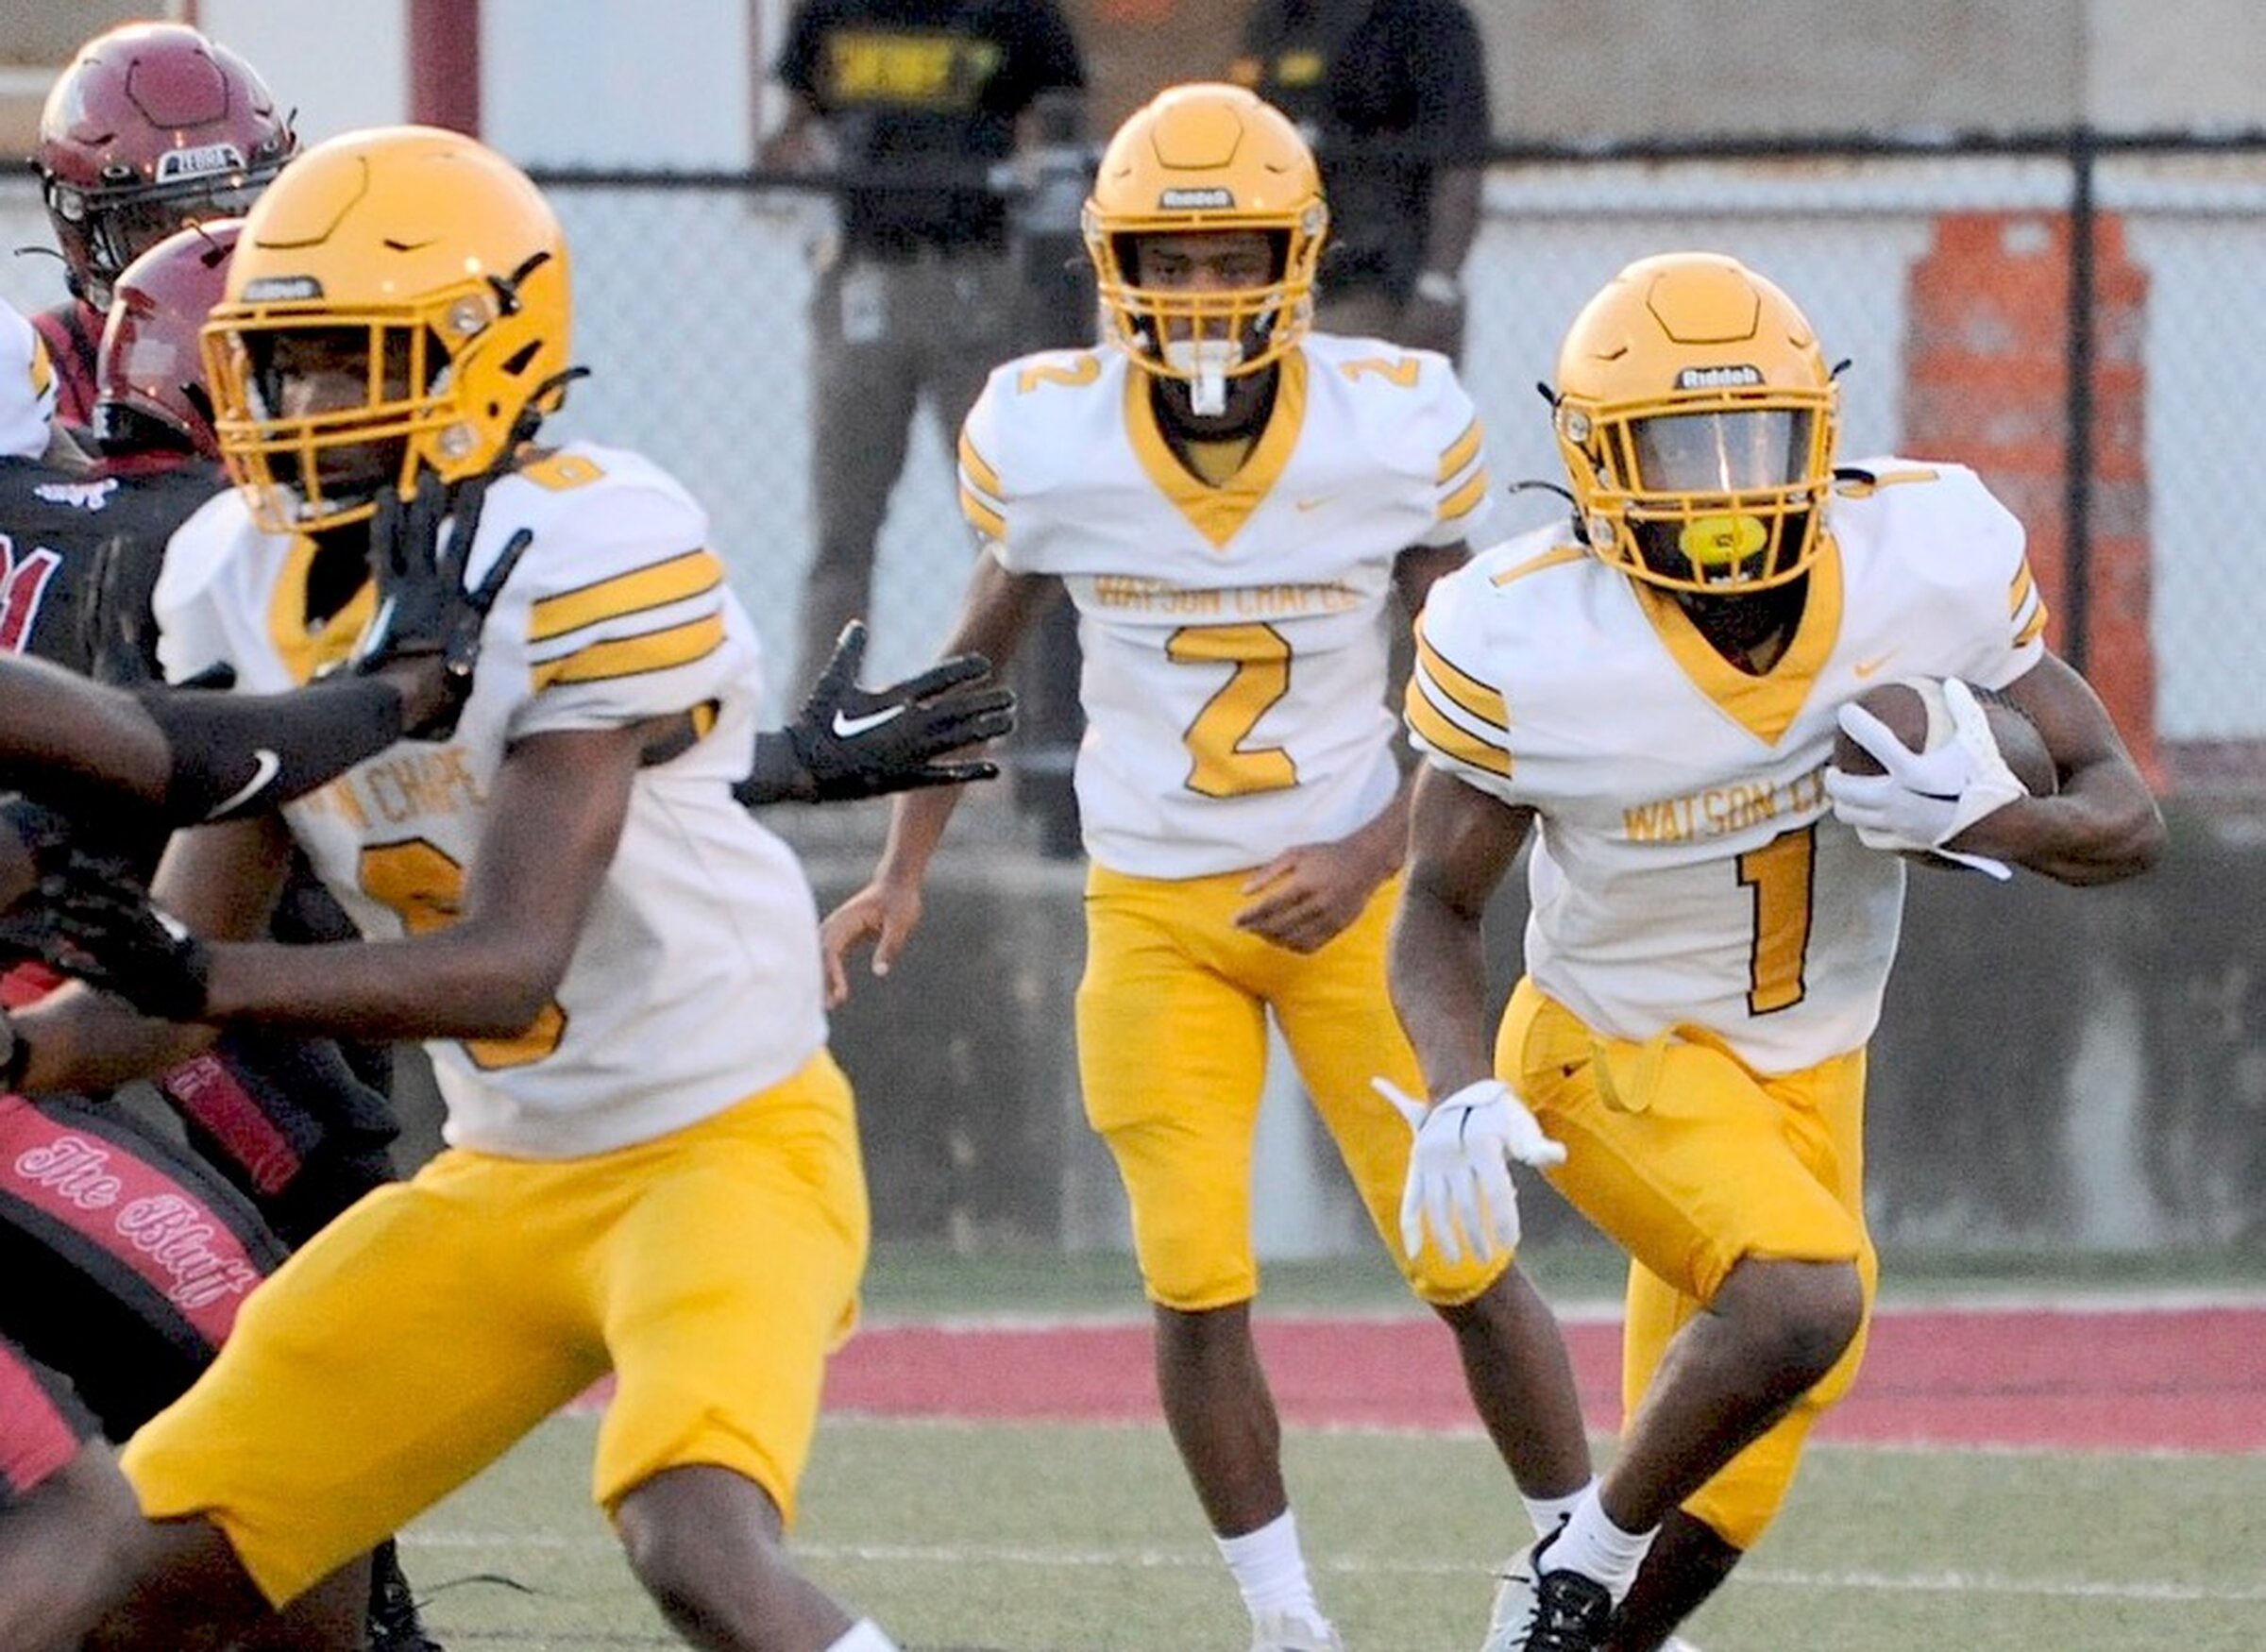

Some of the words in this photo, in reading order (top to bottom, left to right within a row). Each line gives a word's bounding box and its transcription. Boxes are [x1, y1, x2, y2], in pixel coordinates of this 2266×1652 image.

[1682, 366, 1758, 389] Riddell
[1165, 621, 1300, 799] 2
[1623, 780, 1778, 838] WATSON
[1734, 819, 1818, 1018] 1
[14, 1136, 122, 1209] The
[115, 1193, 257, 1308] Bluff
